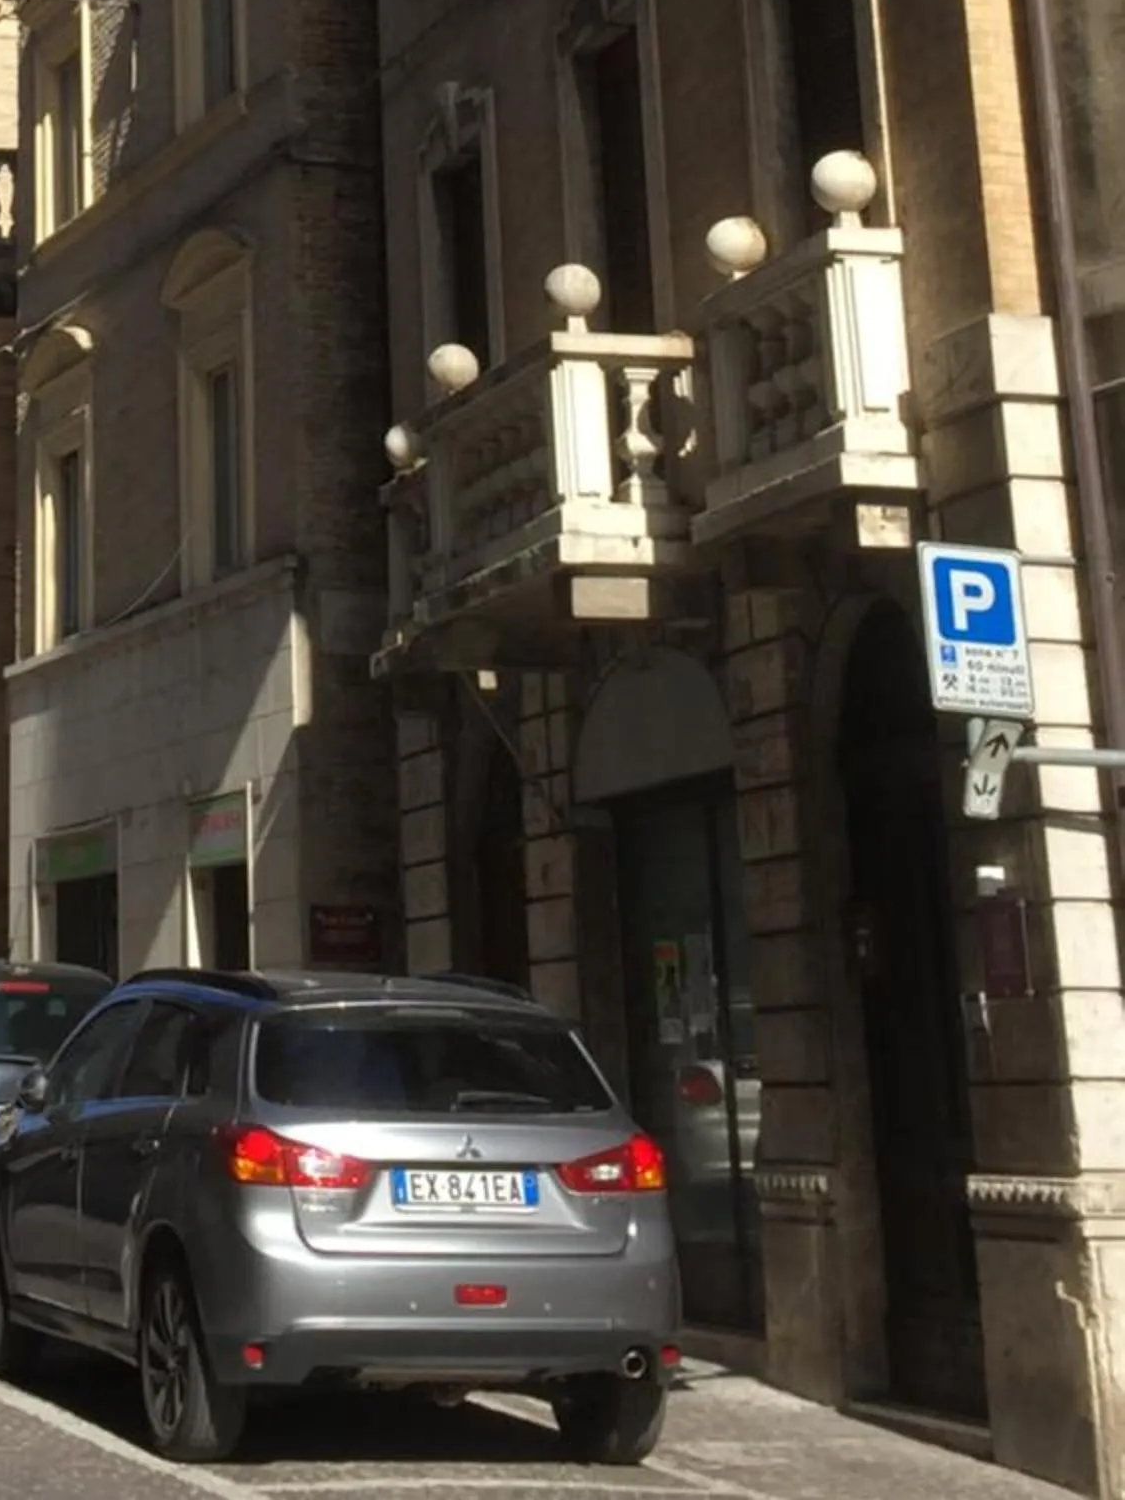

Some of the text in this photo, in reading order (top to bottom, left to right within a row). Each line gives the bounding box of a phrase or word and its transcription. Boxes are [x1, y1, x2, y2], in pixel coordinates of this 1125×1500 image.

[949, 570, 996, 631] P
[410, 1173, 523, 1202] EX 841EA
